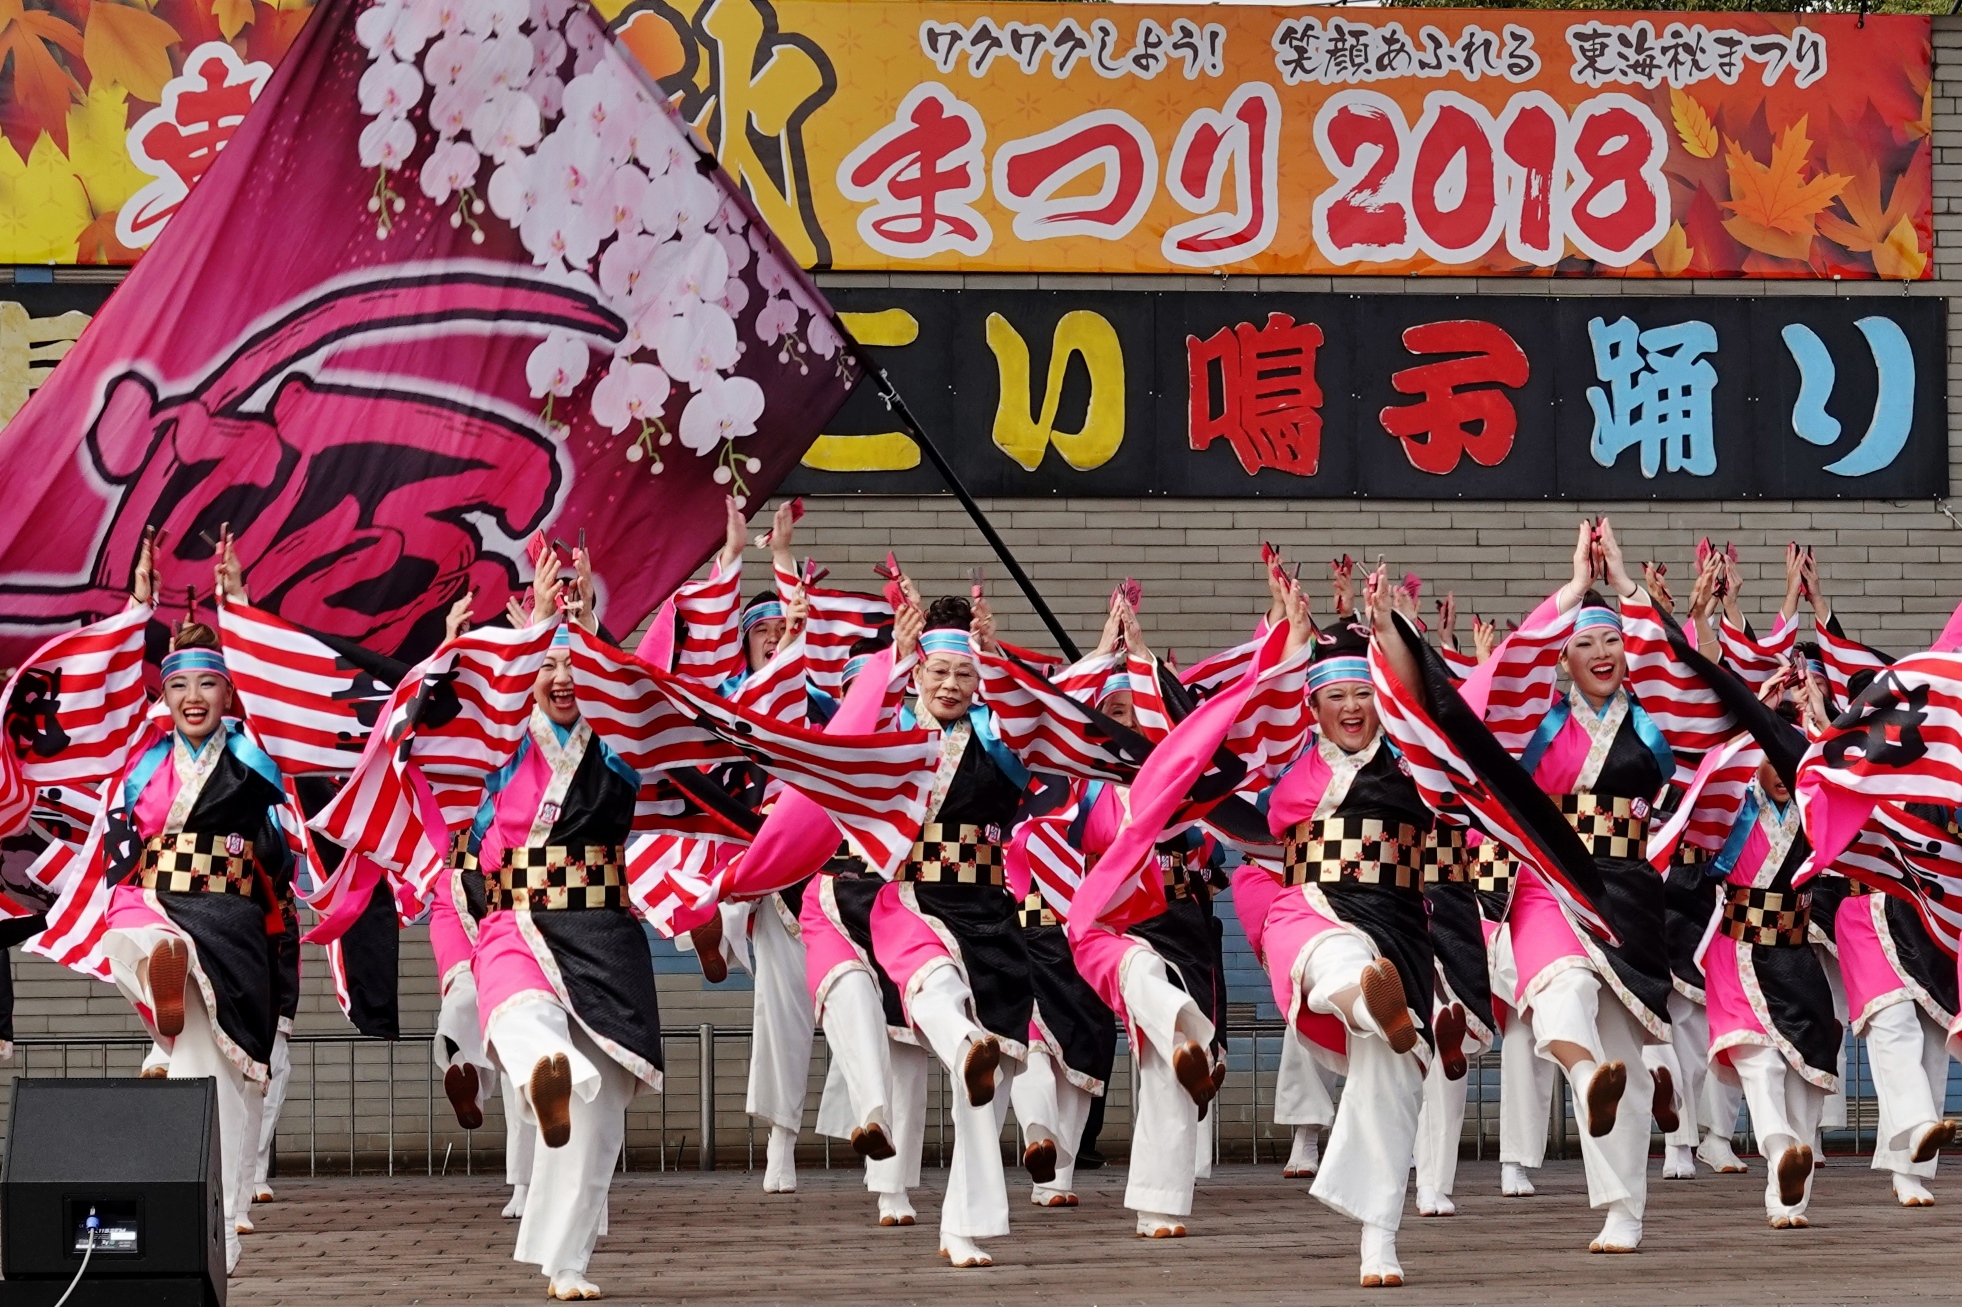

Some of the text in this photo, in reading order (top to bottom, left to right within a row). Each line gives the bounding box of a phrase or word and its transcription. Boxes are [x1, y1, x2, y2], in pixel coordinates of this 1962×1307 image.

[1280, 26, 1537, 76] 笑顔あふれる
[1572, 31, 1823, 78] 東海秋まつり
